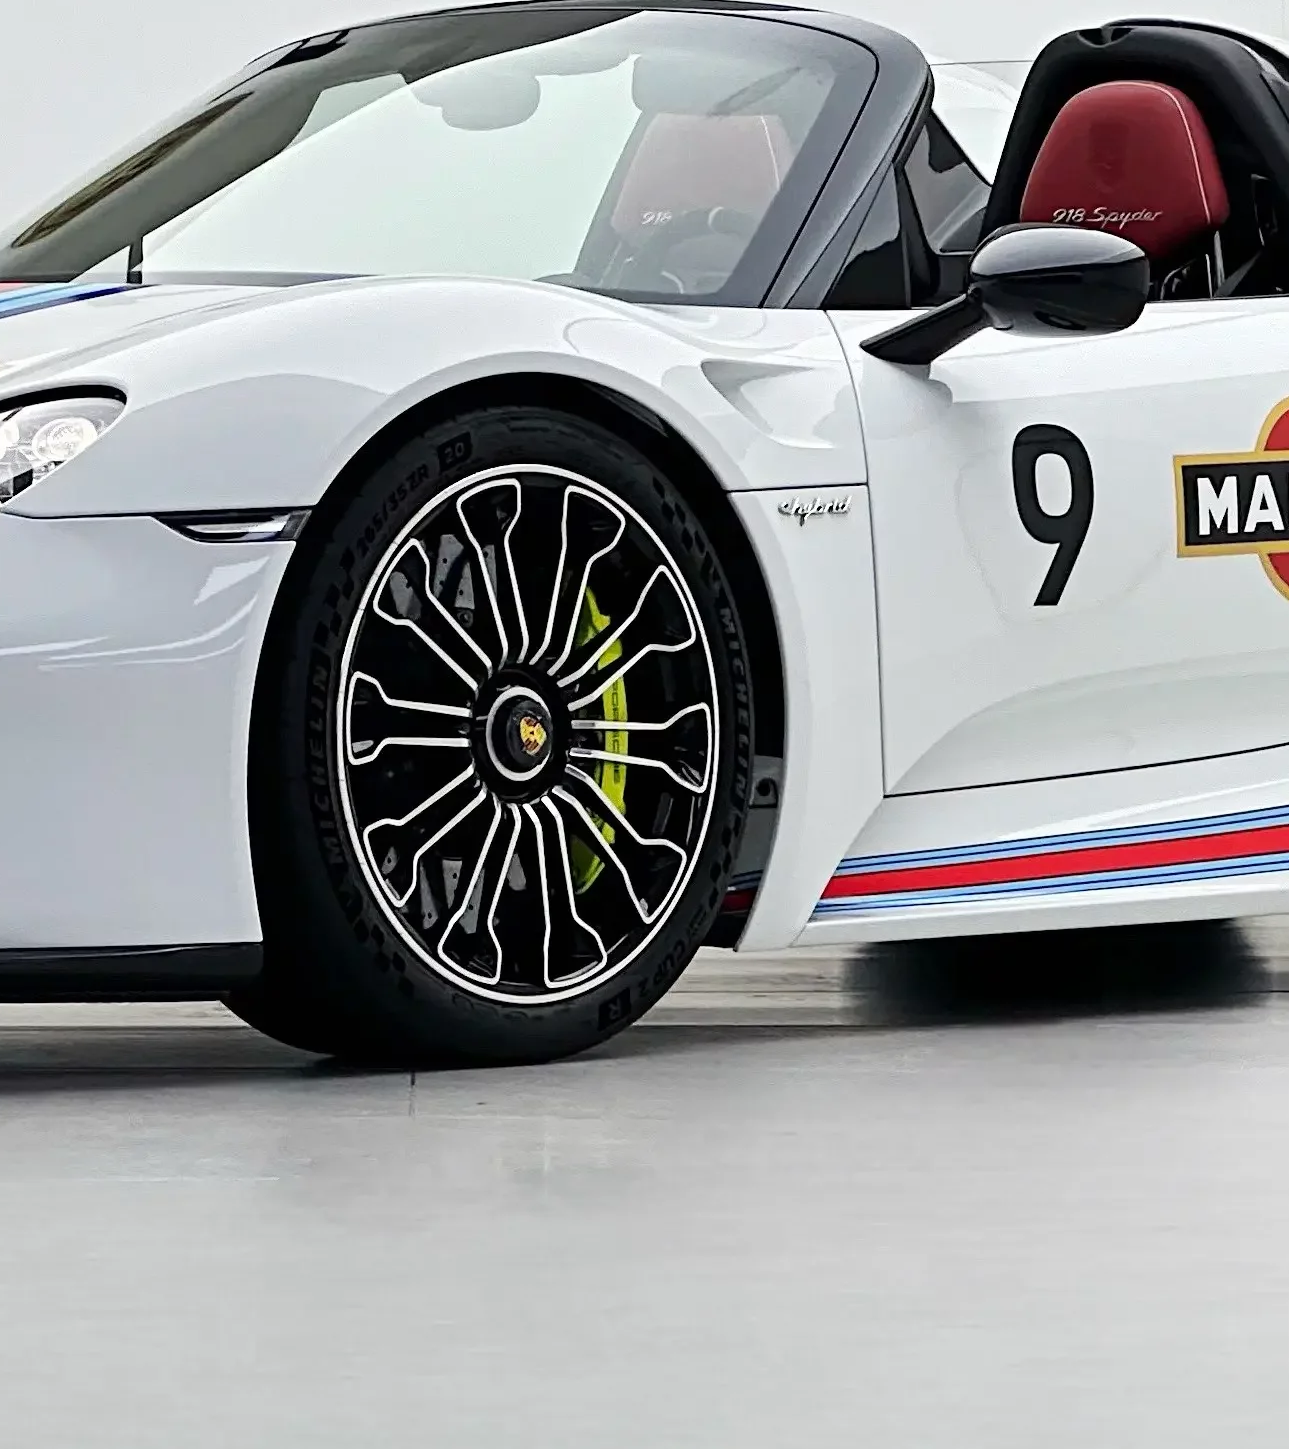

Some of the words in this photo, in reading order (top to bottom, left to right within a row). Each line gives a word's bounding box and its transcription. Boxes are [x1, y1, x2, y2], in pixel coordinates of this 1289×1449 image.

[1052, 208, 1086, 223] 918
[1085, 206, 1164, 230] Spyder
[1011, 423, 1095, 607] 9
